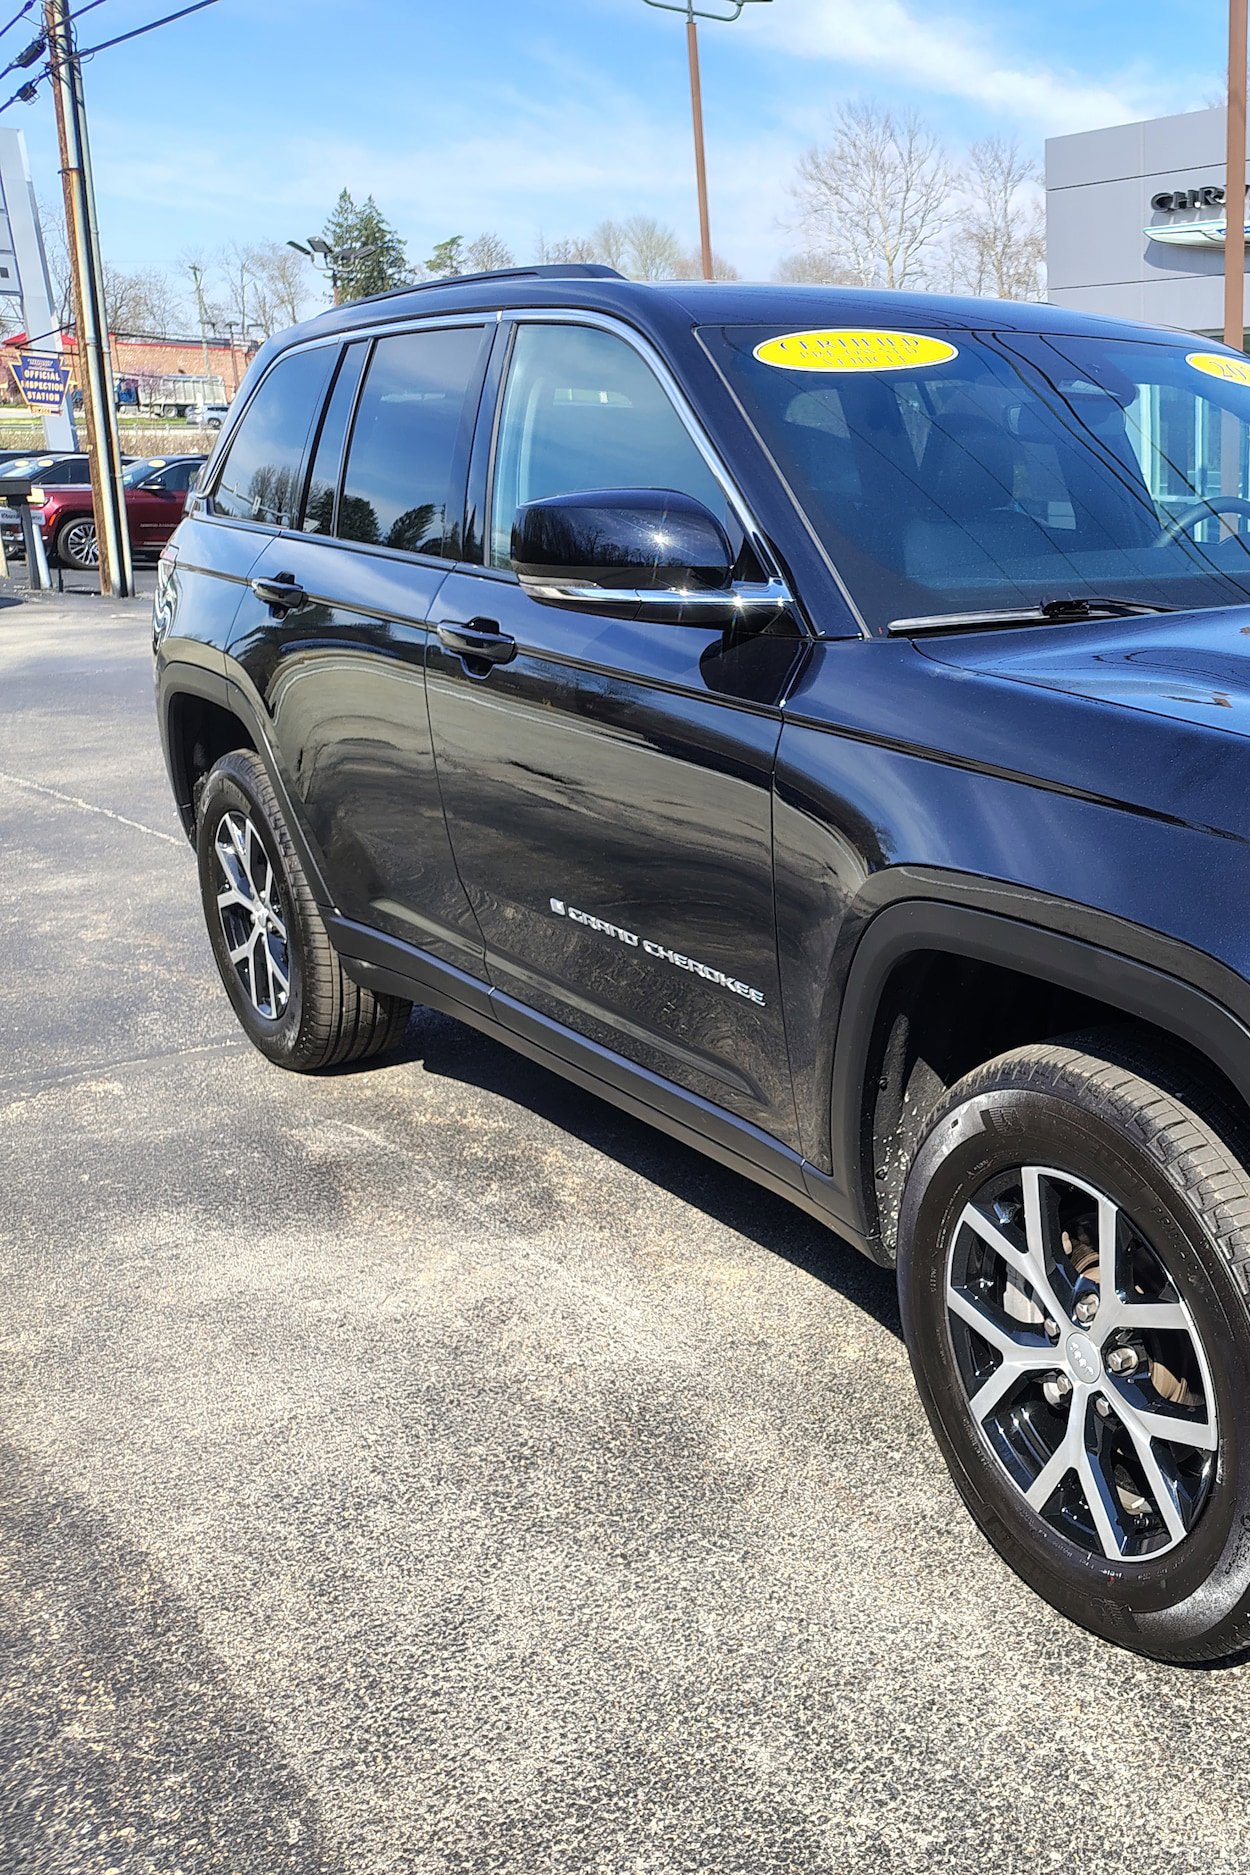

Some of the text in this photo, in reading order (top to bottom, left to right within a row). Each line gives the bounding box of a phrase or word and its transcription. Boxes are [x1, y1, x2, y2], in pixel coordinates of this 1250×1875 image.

[24, 370, 60, 380] OFFICIAL
[21, 380, 64, 391] INSPECTION
[27, 391, 60, 402] STATION
[568, 907, 766, 1006] GRAND CHEROKEE
